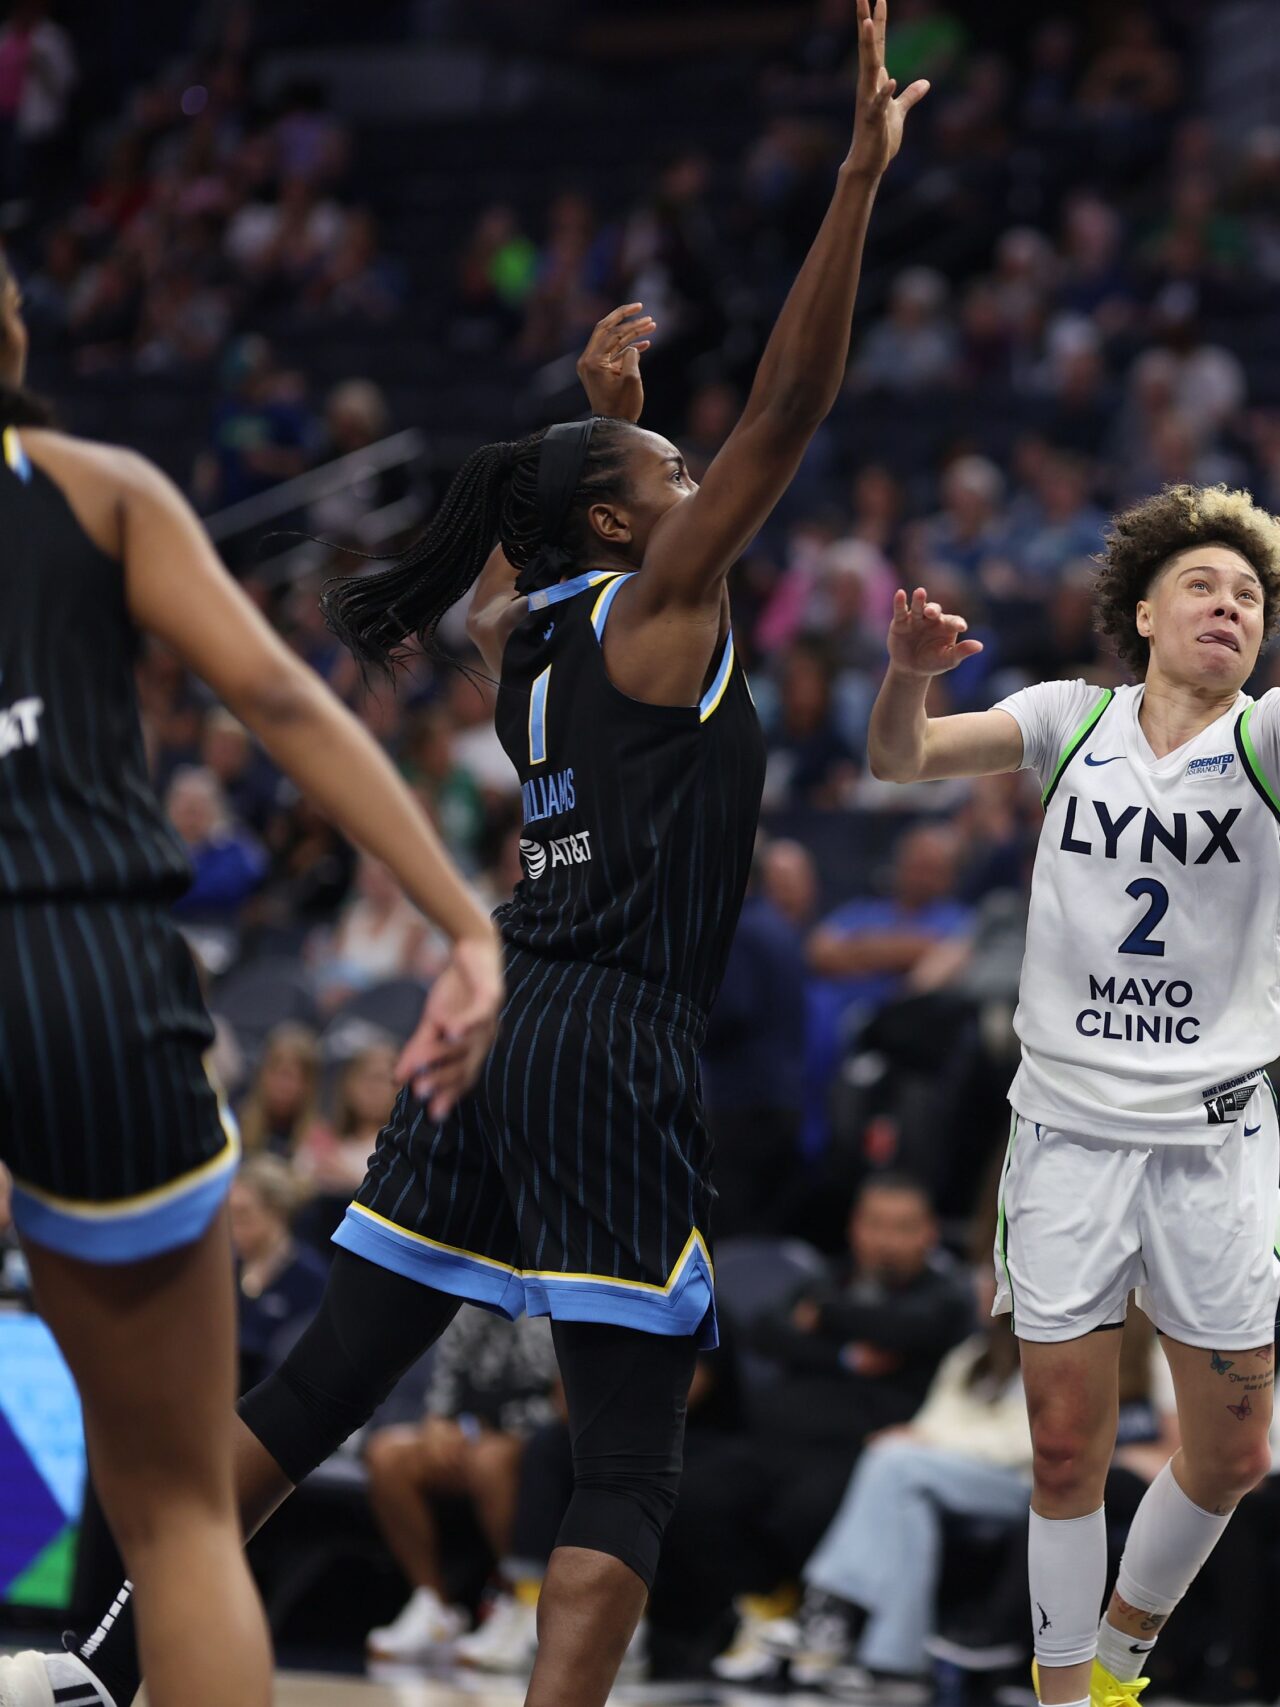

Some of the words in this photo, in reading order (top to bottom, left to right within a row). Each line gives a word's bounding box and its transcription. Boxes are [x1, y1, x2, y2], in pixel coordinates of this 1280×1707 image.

[528, 663, 552, 766] 1
[1188, 754, 1234, 768] FEDERATED
[1060, 796, 1242, 866] LYNX
[549, 831, 592, 868] AT&T
[1118, 877, 1169, 957] 2
[1089, 974, 1193, 1008] MAYO
[1075, 1009, 1200, 1044] CLINIC
[1202, 1086, 1218, 1098] NIKE
[1218, 1076, 1247, 1092] HEROINE
